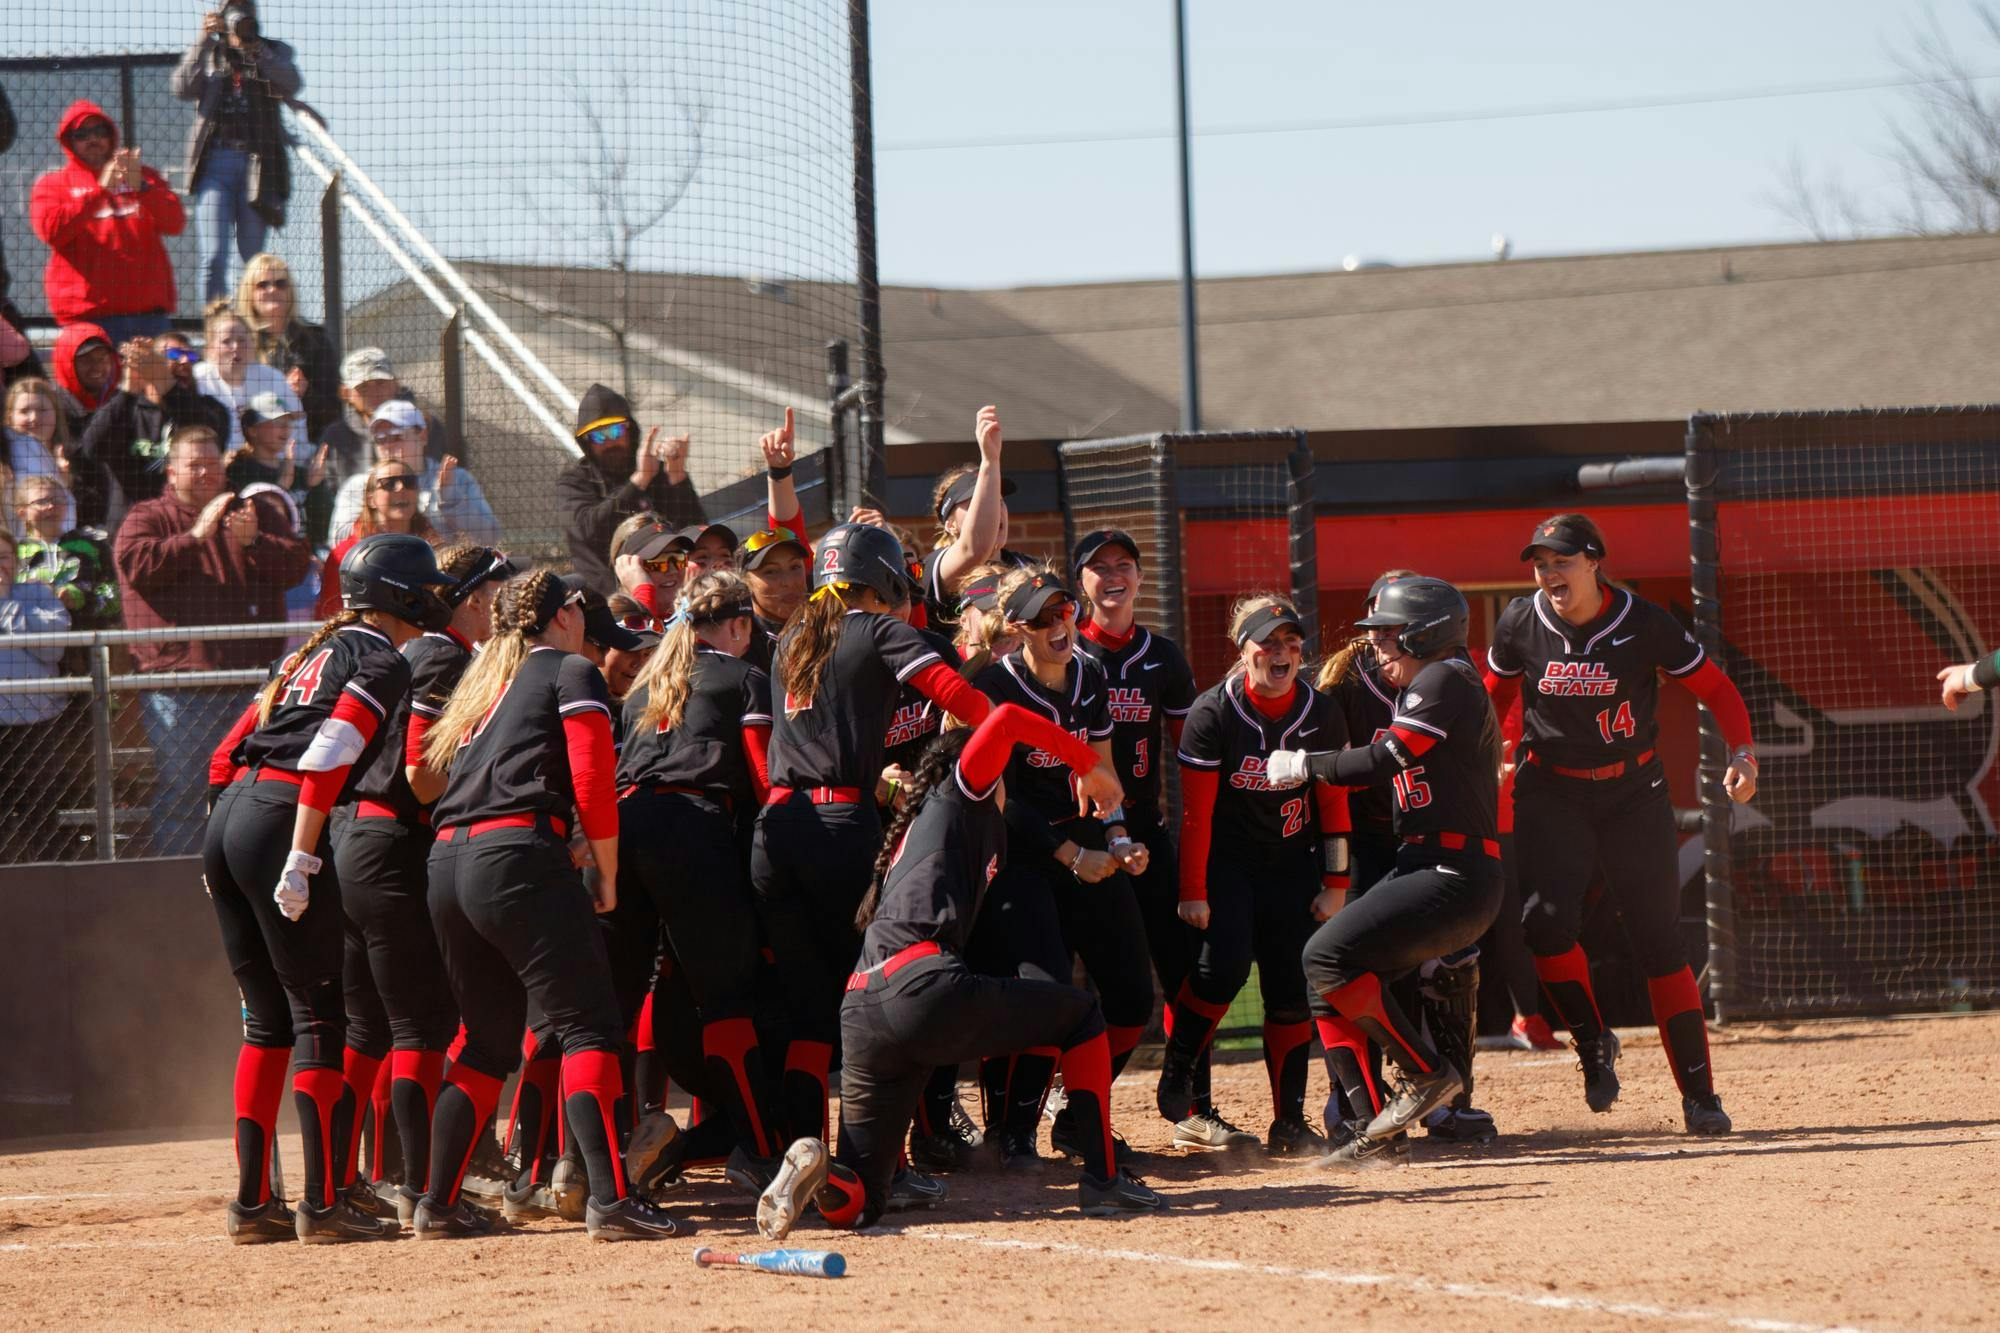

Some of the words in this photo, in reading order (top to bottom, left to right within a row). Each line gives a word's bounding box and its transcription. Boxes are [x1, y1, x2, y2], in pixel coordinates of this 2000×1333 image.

[824, 548, 839, 571] 2
[1545, 661, 1609, 680] BALL
[1108, 688, 1145, 705] ALL
[1538, 678, 1618, 696] STATE
[889, 701, 925, 731] ALL
[1108, 705, 1152, 722] ATE
[1596, 700, 1636, 744] 14
[885, 714, 938, 748] TATE
[1133, 738, 1149, 778] 3
[1393, 765, 1432, 812] 15
